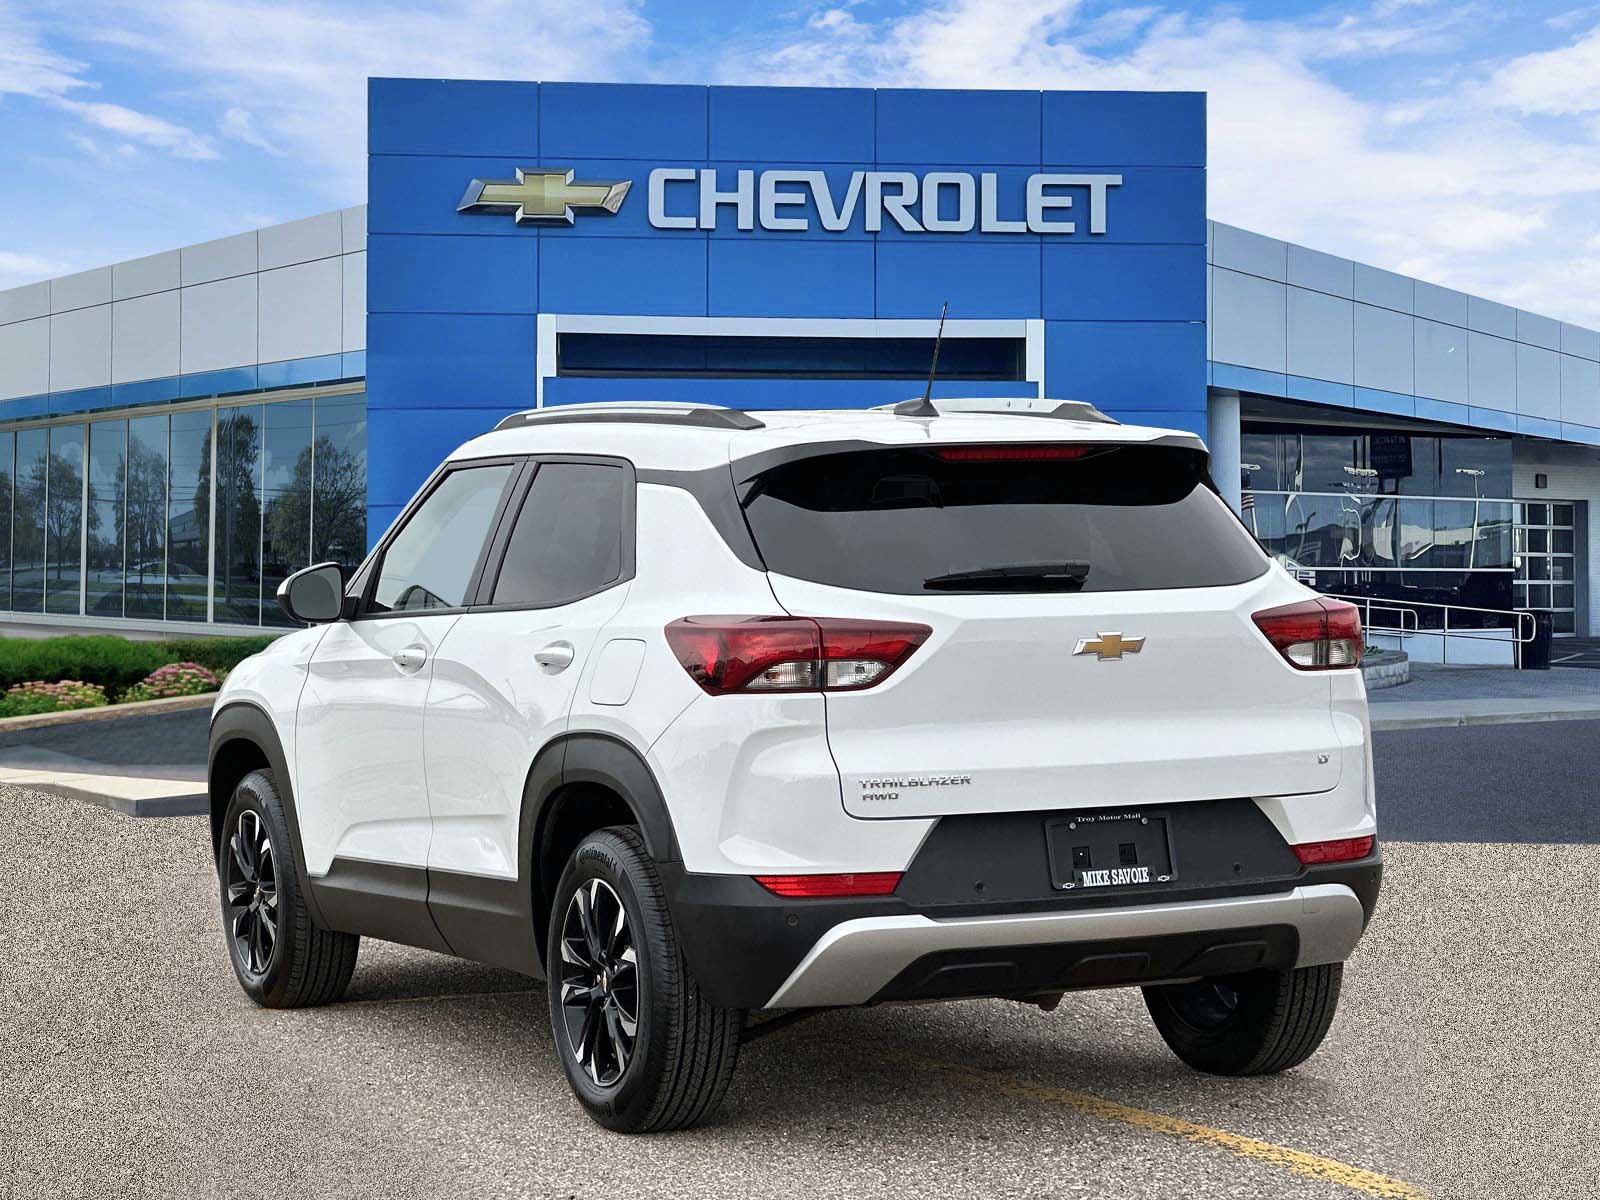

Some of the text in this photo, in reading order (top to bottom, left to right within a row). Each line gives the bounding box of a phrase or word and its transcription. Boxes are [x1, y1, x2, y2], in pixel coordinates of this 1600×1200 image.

[648, 167, 1123, 234] CHEVROLET
[859, 776, 972, 789] TRAILBLAZER
[862, 792, 899, 801] AWD
[1082, 867, 1150, 887] MIKE SAVOIE
